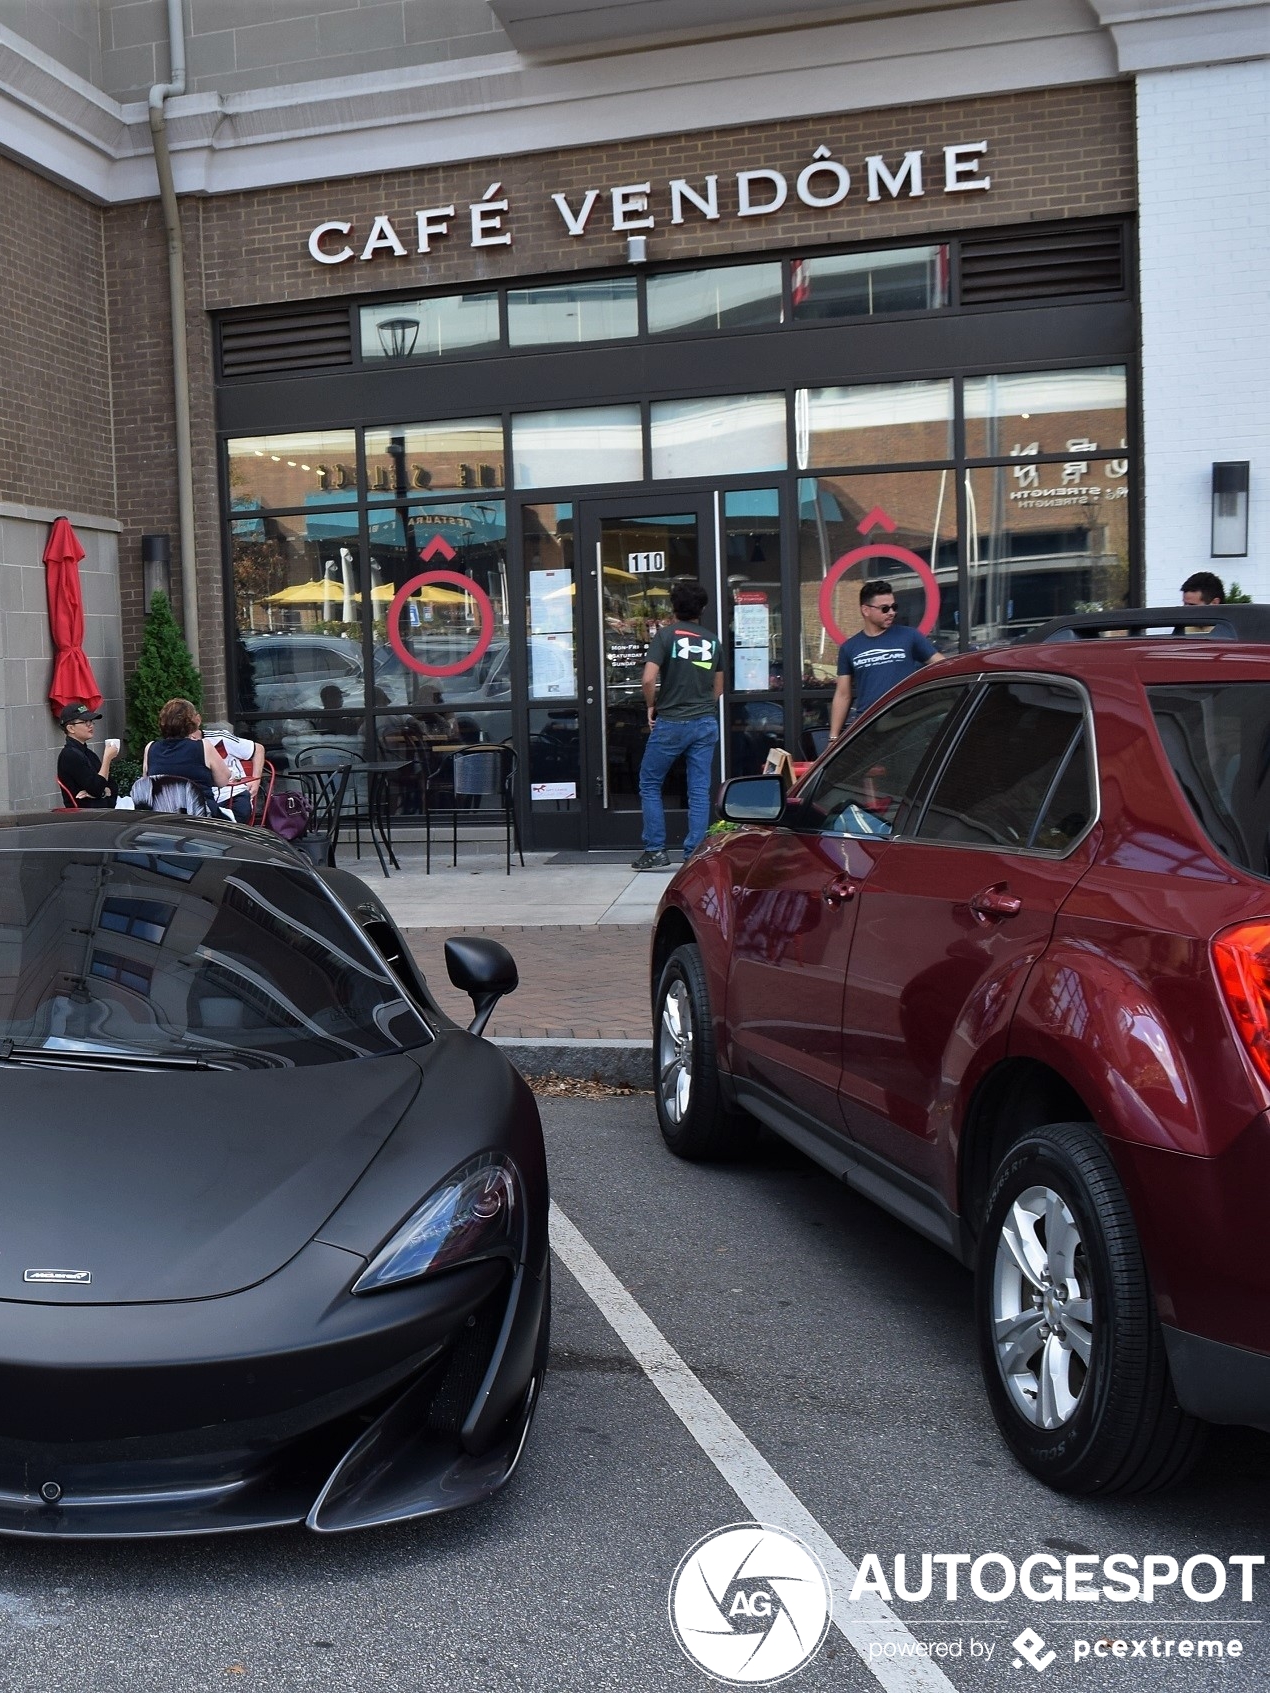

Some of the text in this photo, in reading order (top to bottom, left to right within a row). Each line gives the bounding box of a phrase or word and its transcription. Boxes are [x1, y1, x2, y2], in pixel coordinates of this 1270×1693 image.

[308, 140, 992, 264] CAFÉ VENDÔME
[632, 552, 663, 572] 110
